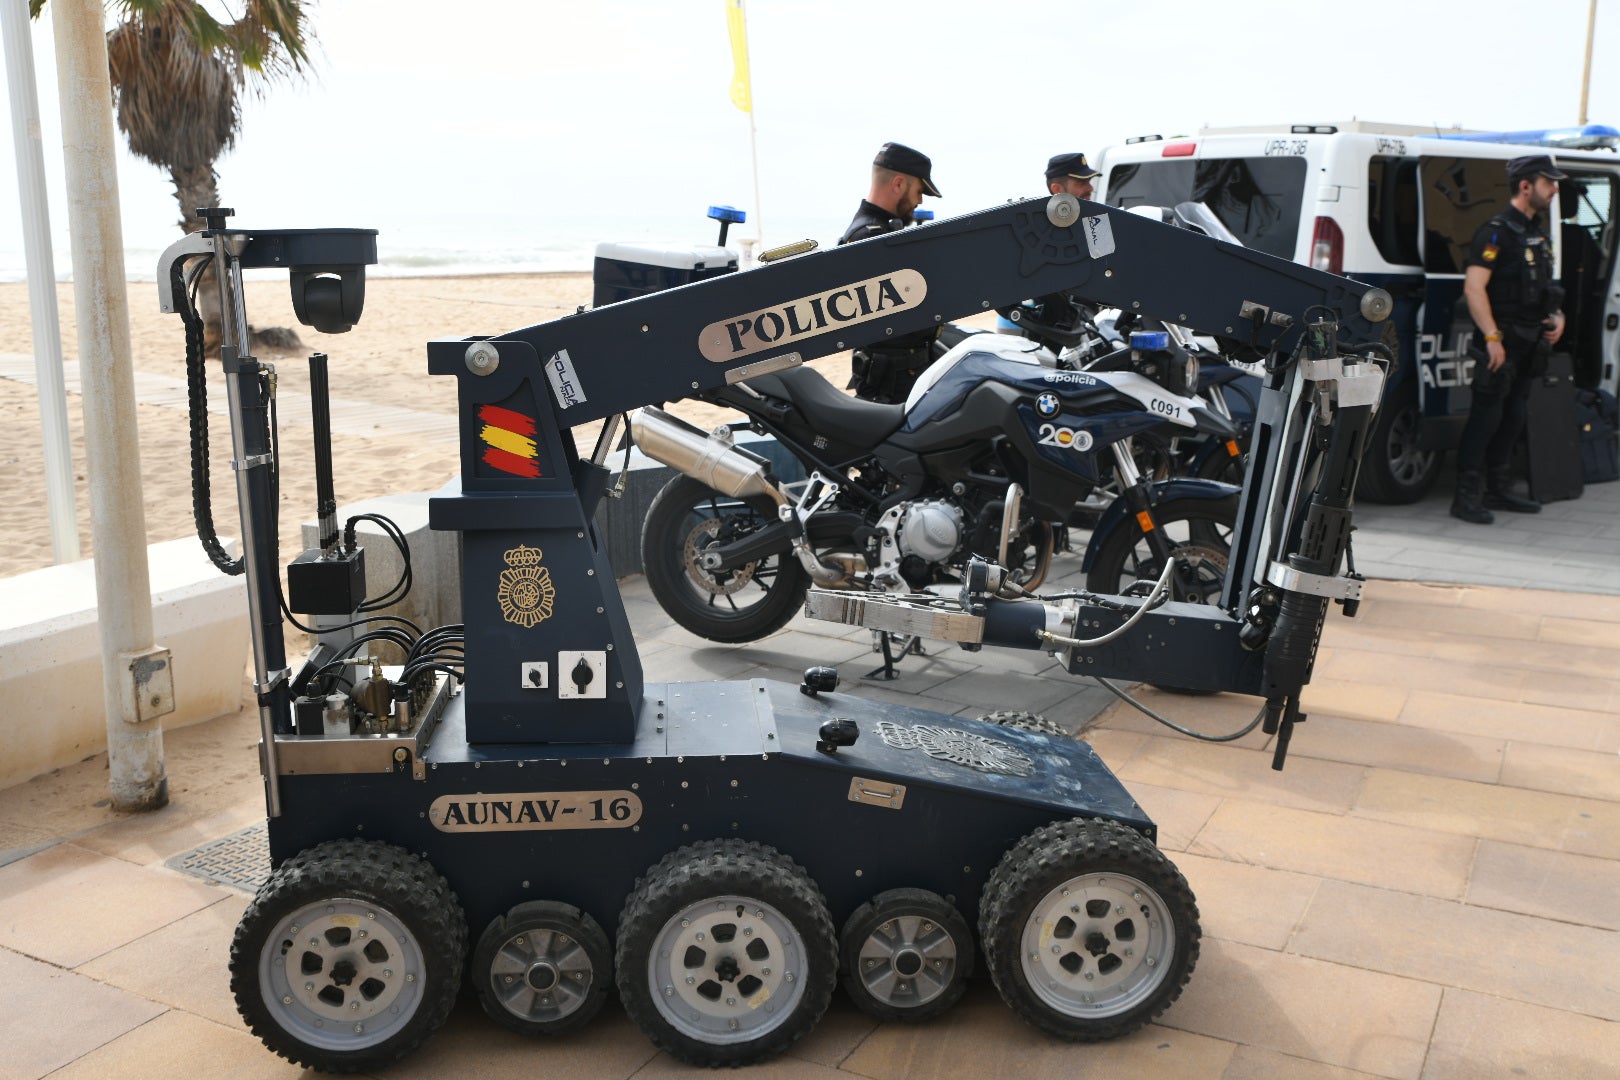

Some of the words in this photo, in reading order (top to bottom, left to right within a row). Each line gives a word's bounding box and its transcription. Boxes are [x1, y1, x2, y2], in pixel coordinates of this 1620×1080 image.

[724, 277, 906, 353] POLICIA
[1043, 374, 1096, 385] @policia
[1150, 398, 1181, 418] C091
[1037, 423, 1094, 452] 200
[442, 799, 576, 826] AUNAV-
[589, 797, 631, 822] 16
